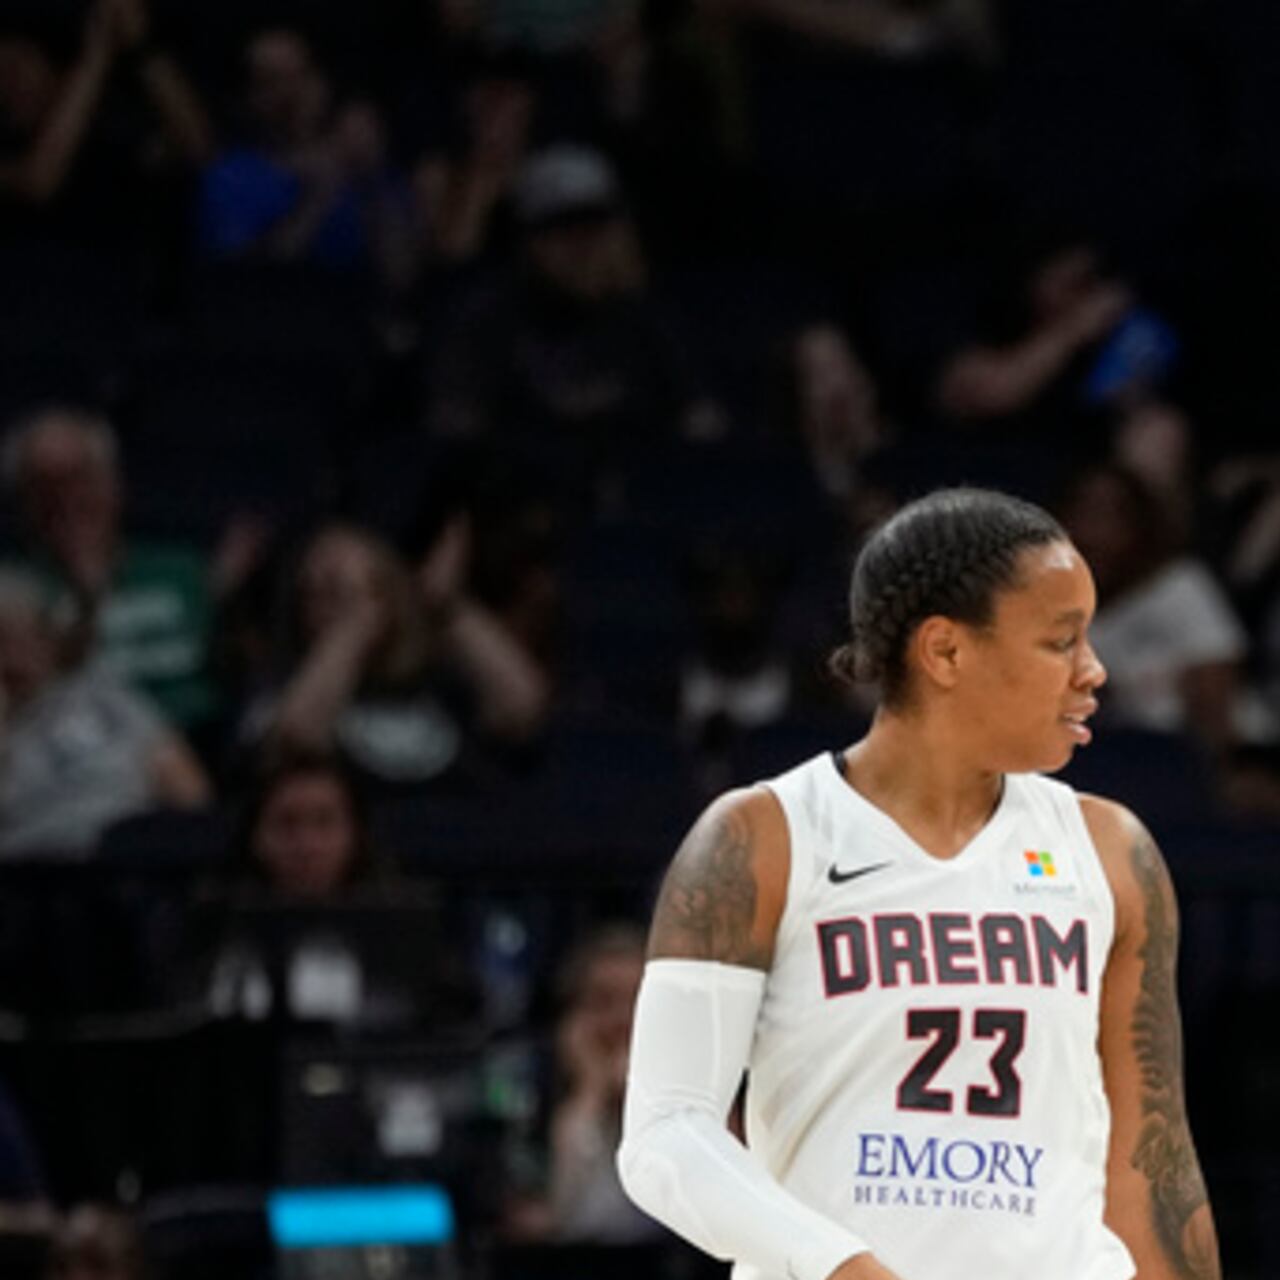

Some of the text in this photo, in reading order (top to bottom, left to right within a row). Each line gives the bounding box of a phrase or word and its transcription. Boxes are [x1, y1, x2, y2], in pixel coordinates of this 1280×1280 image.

[816, 912, 1089, 999] DREAM
[896, 1007, 1027, 1118] 23
[855, 1133, 1044, 1188] EMORY
[854, 1186, 1036, 1216] HEALTHCARE
